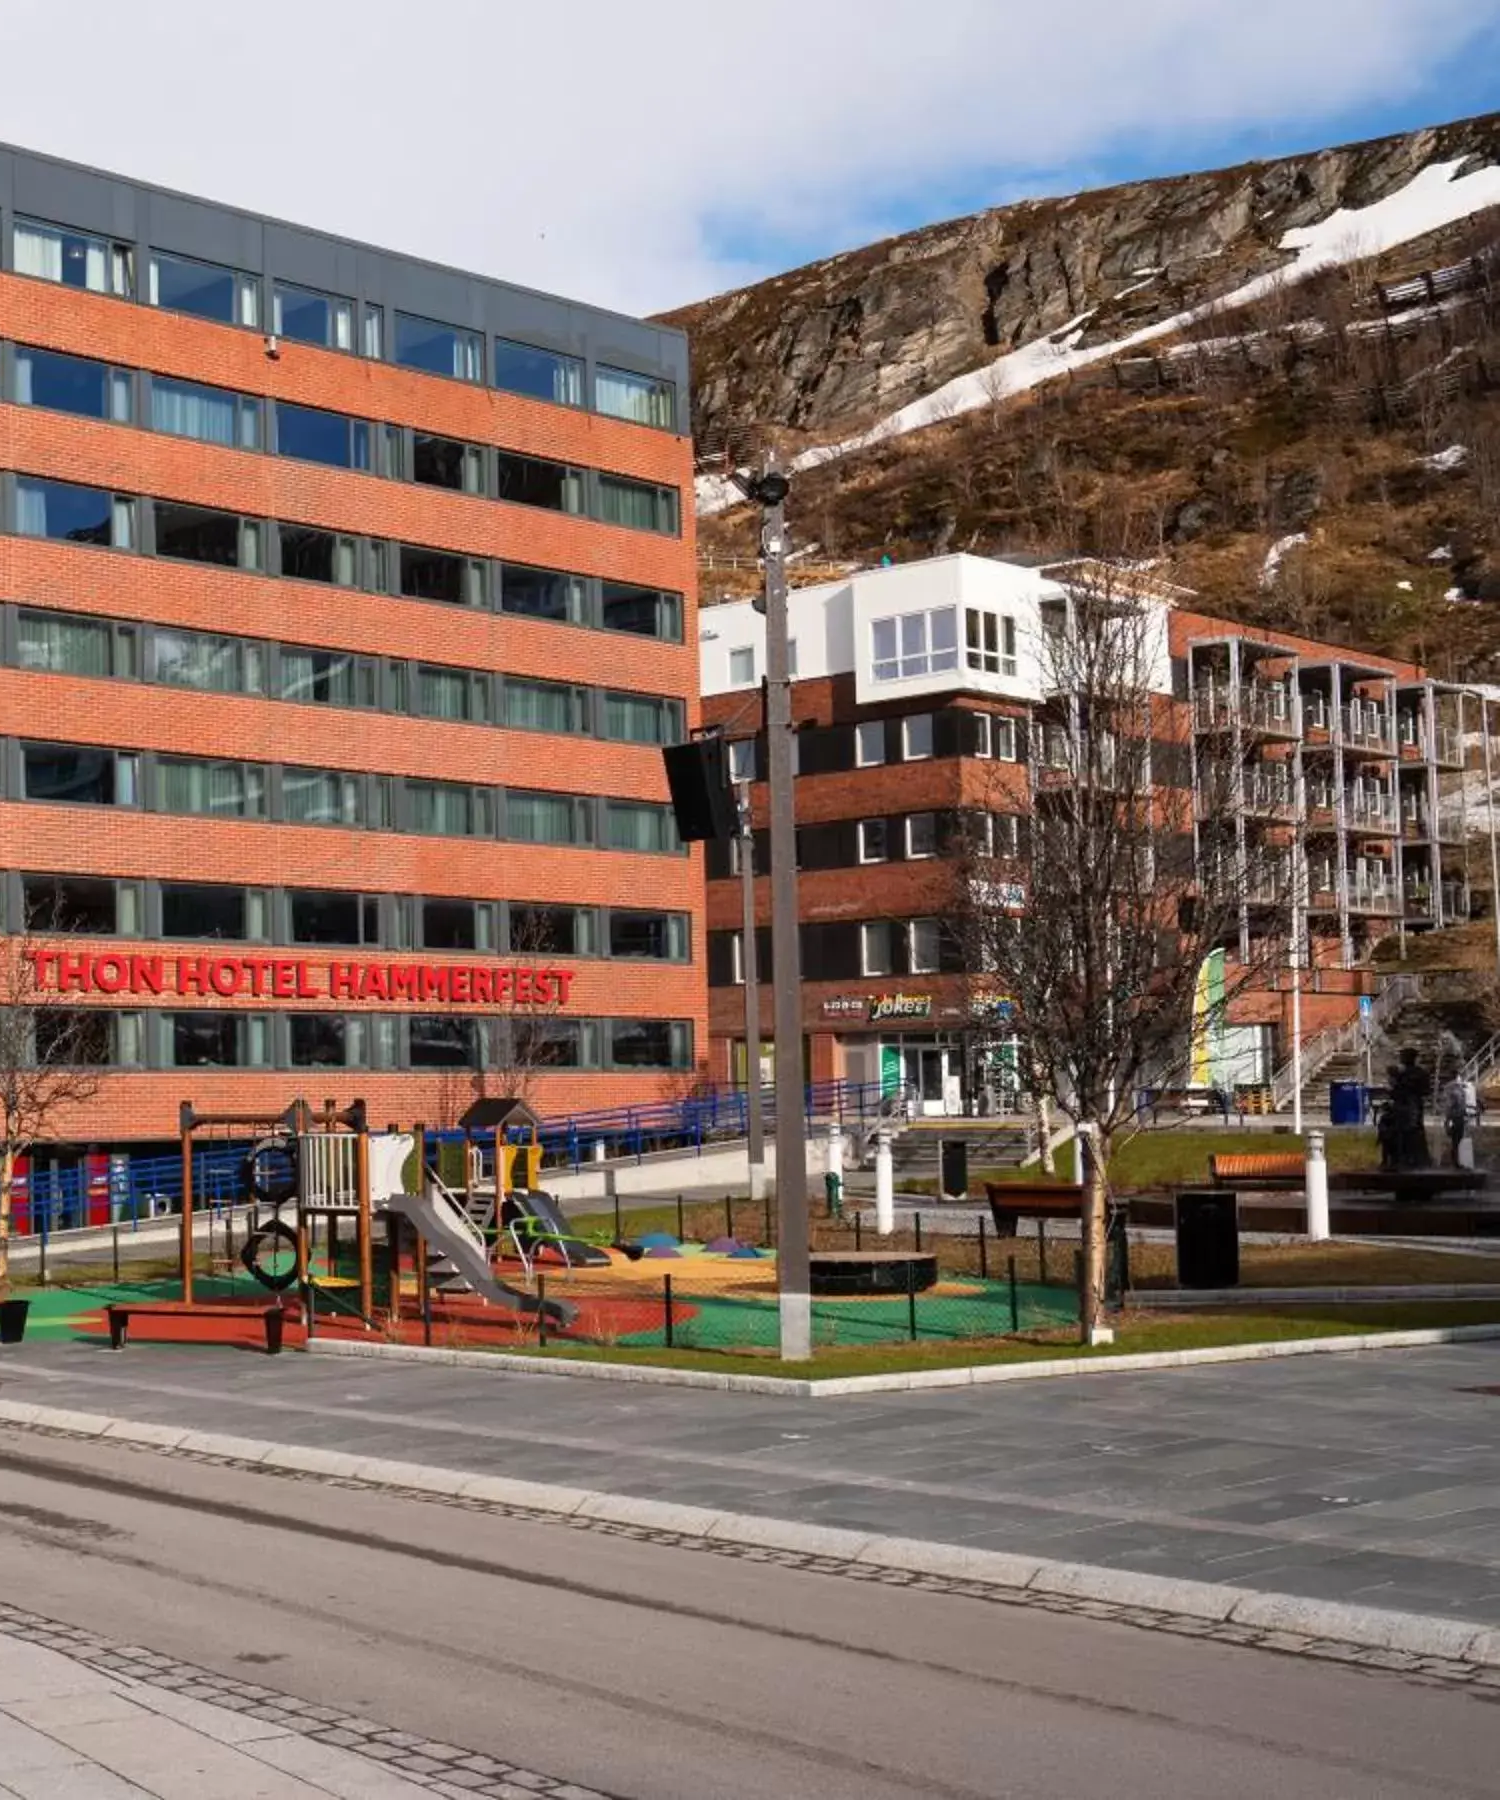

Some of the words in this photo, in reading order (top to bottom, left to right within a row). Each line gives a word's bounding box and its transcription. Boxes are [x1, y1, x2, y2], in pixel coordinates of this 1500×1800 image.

[33, 951, 163, 995] THON
[177, 956, 320, 999] HOTEL
[329, 961, 576, 1006] HAMMERFEST
